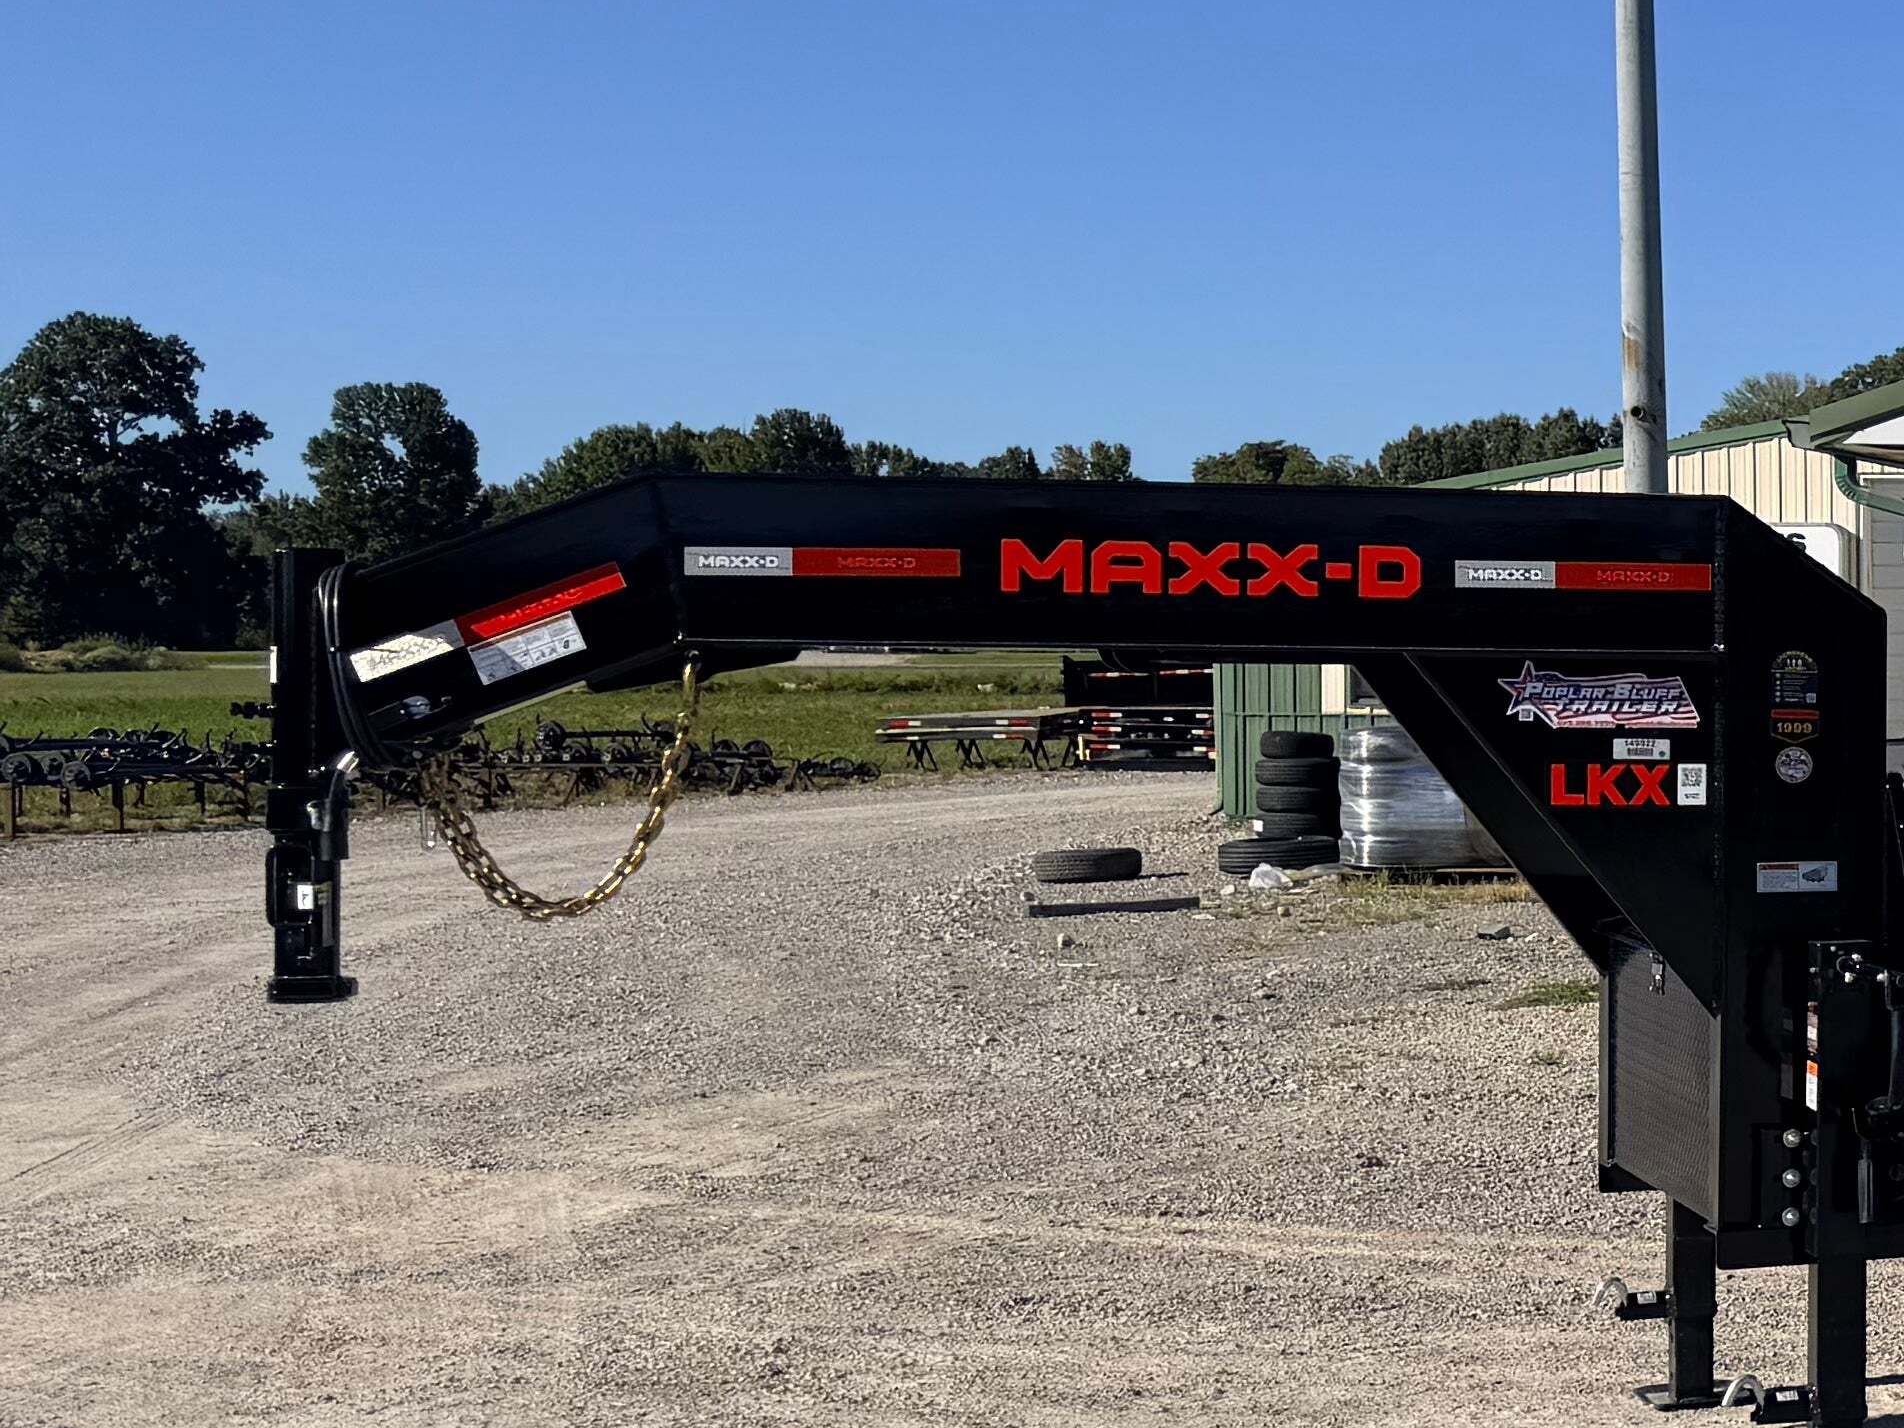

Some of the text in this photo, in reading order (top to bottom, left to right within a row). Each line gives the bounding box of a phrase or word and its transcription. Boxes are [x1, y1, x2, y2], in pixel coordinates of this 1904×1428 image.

[1000, 539, 1421, 598] MAXX-D
[1524, 682, 1682, 700] POPLAR BLUFF
[1556, 700, 1679, 713] TRAILER
[1550, 763, 1671, 805] LKX
